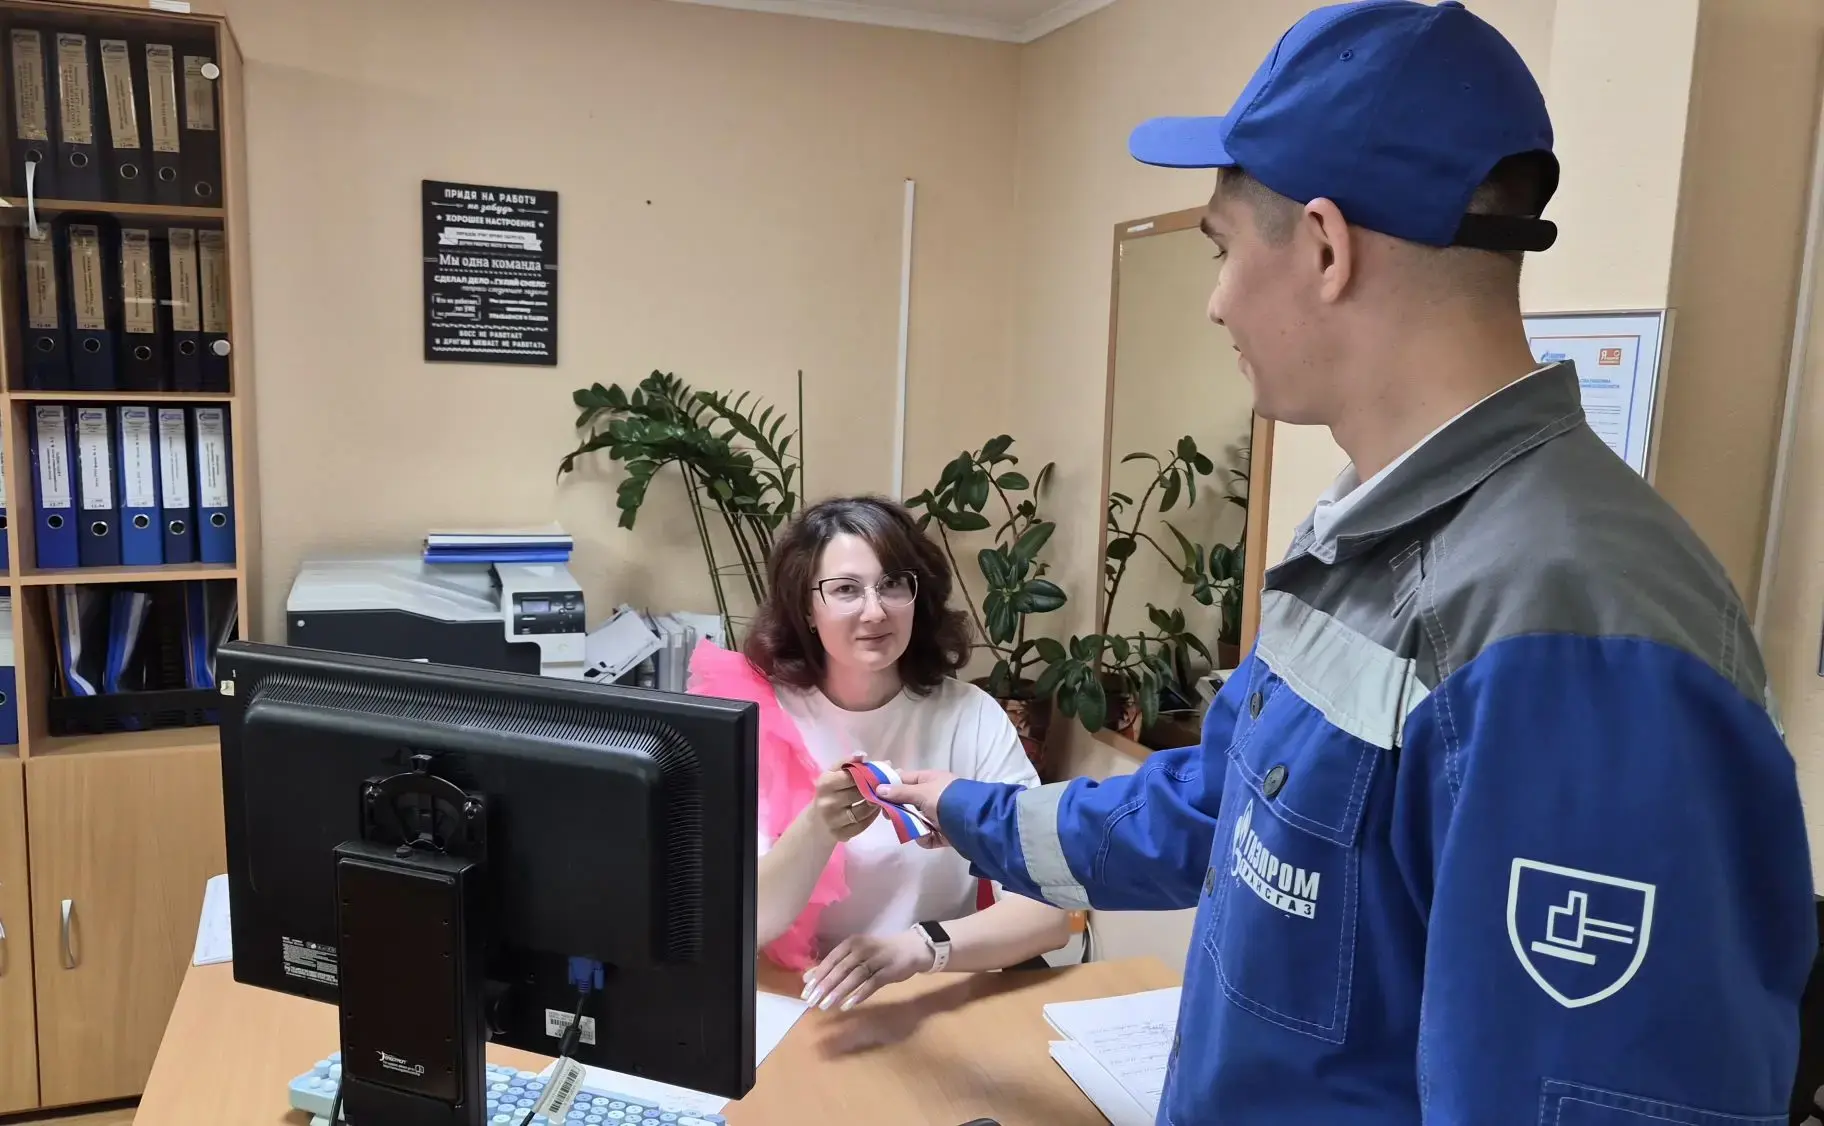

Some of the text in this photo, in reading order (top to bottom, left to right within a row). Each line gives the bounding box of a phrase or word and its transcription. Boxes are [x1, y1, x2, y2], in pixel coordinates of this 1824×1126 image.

[444, 188, 536, 205] ПРИДЯ НА РАБОТУ
[479, 203, 514, 215] забудь
[445, 214, 536, 228] ХОРОШЕЕ НАСТРОЕНИЕ
[439, 254, 542, 271] Мы одна команда
[434, 275, 467, 284] СДЕЛАЛ
[467, 276, 490, 285] ДЕЛО
[494, 278, 519, 287] ГУЛЯЙ
[458, 330, 476, 338] БОСС
[489, 331, 523, 339] РАБОТАЕТ
[443, 338, 470, 346] ДРУГИМ
[473, 339, 499, 347] МЕШАЕТ
[501, 340, 510, 348] НЕ
[512, 341, 546, 349] РАБОТАТЬ
[1243, 829, 1321, 901] ГАЗПРОМ
